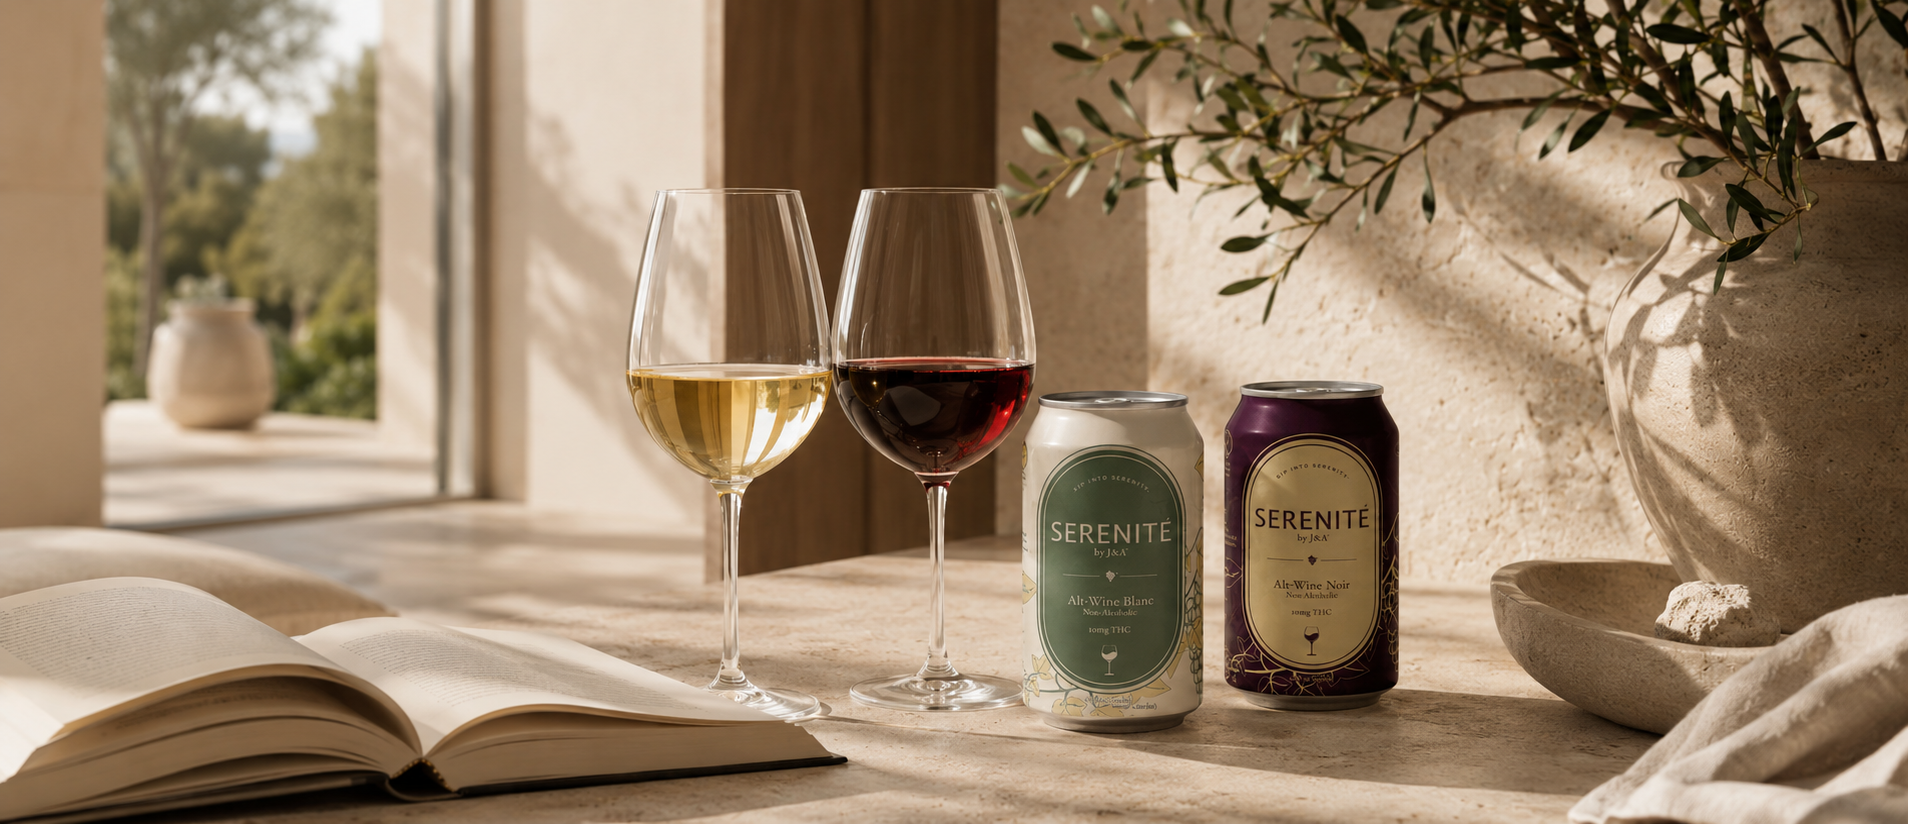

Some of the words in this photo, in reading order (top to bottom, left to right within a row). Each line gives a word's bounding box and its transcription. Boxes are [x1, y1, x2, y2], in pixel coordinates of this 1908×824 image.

[1290, 463, 1308, 472] INTO
[1254, 504, 1370, 530] SERENITÉ
[1050, 517, 1172, 544] SERENITÉ
[1297, 533, 1308, 544] by
[1094, 548, 1105, 558] by
[1273, 580, 1322, 590] Alt-Wine
[1326, 580, 1350, 590] Noir
[1068, 595, 1120, 607] Alt-Wine
[1123, 595, 1154, 606] Blanc
[1110, 626, 1131, 634] THC
